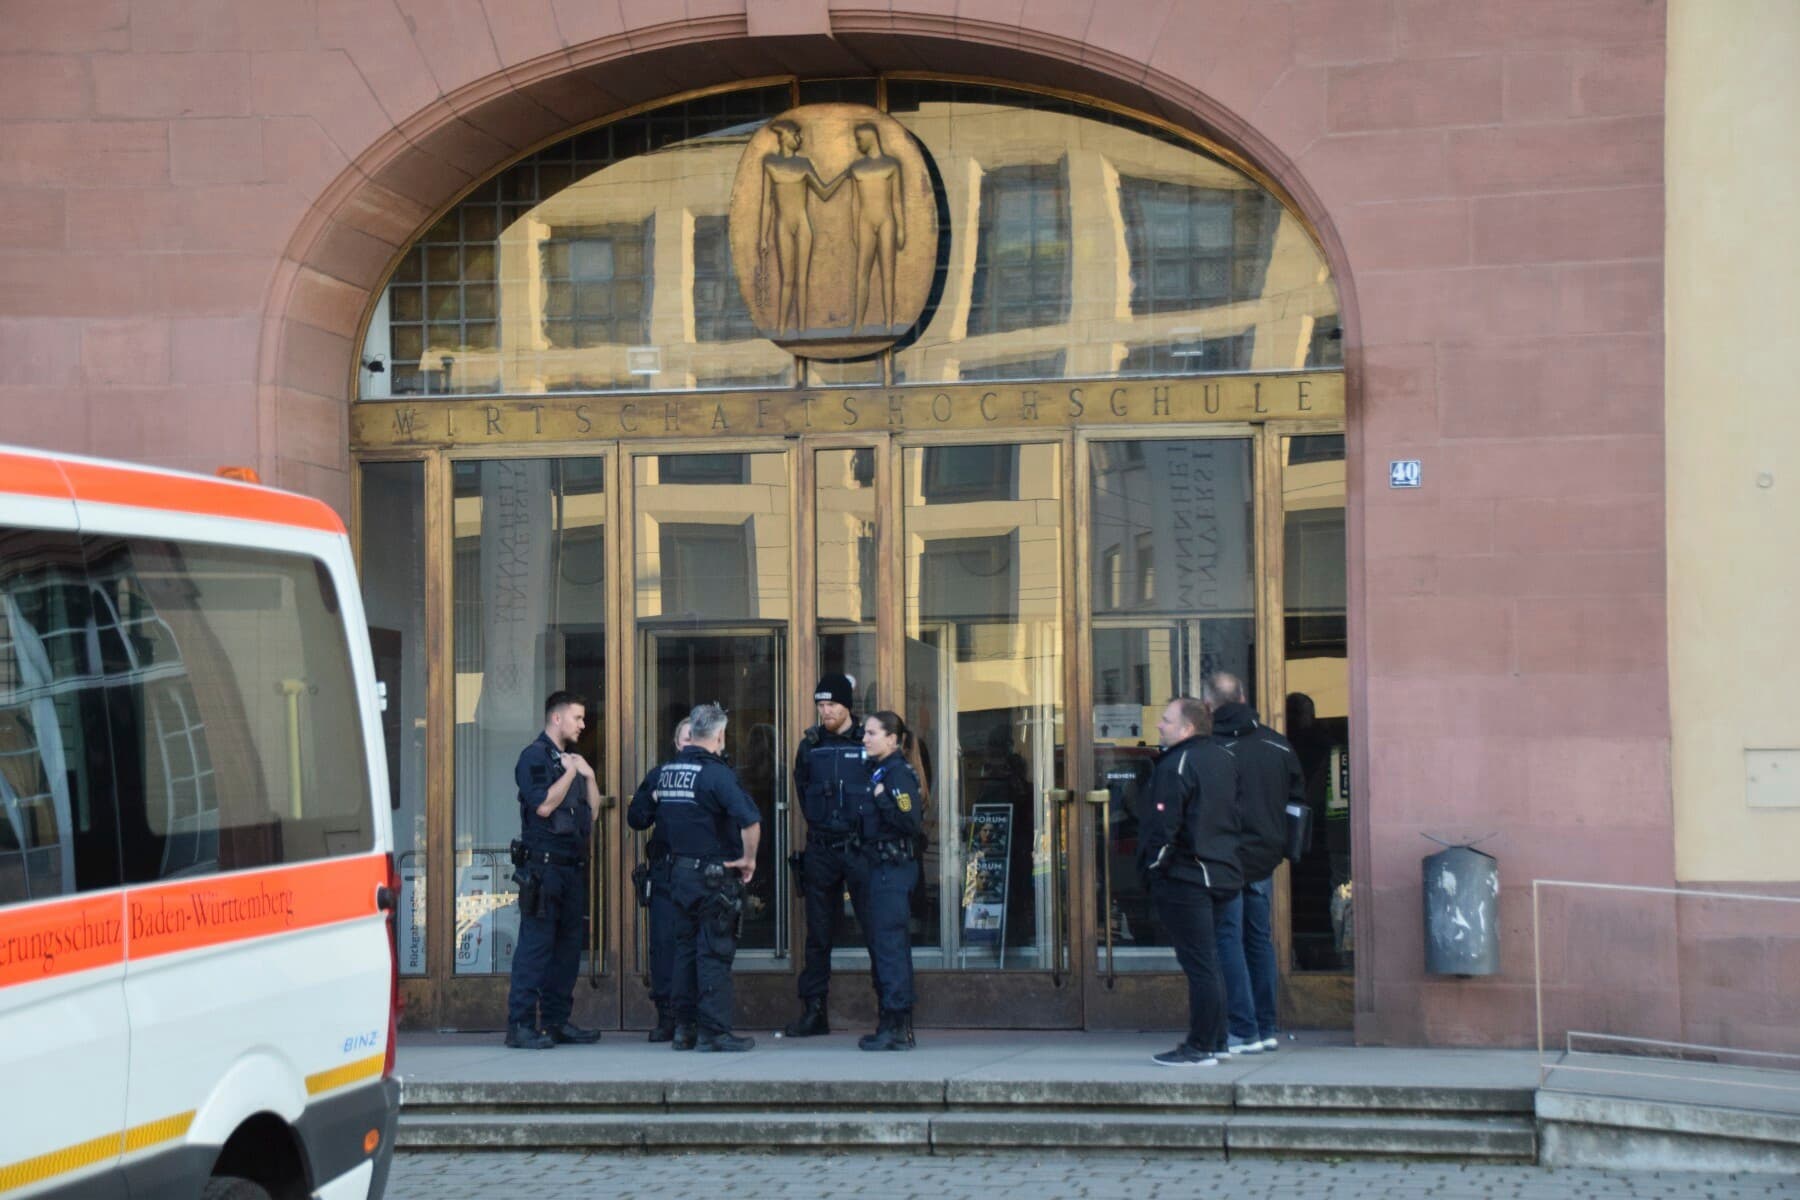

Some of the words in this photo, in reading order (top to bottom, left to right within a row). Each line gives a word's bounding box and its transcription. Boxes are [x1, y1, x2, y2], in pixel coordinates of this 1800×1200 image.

[395, 380, 1314, 437] WIRTSCHAFTSHOCHSCHULE
[1392, 462, 1418, 481] 40
[658, 771, 697, 789] POLIZEI
[975, 862, 1003, 871] ORUM
[131, 882, 294, 939] Baden-Württemberg
[343, 1030, 379, 1052] BINZ
